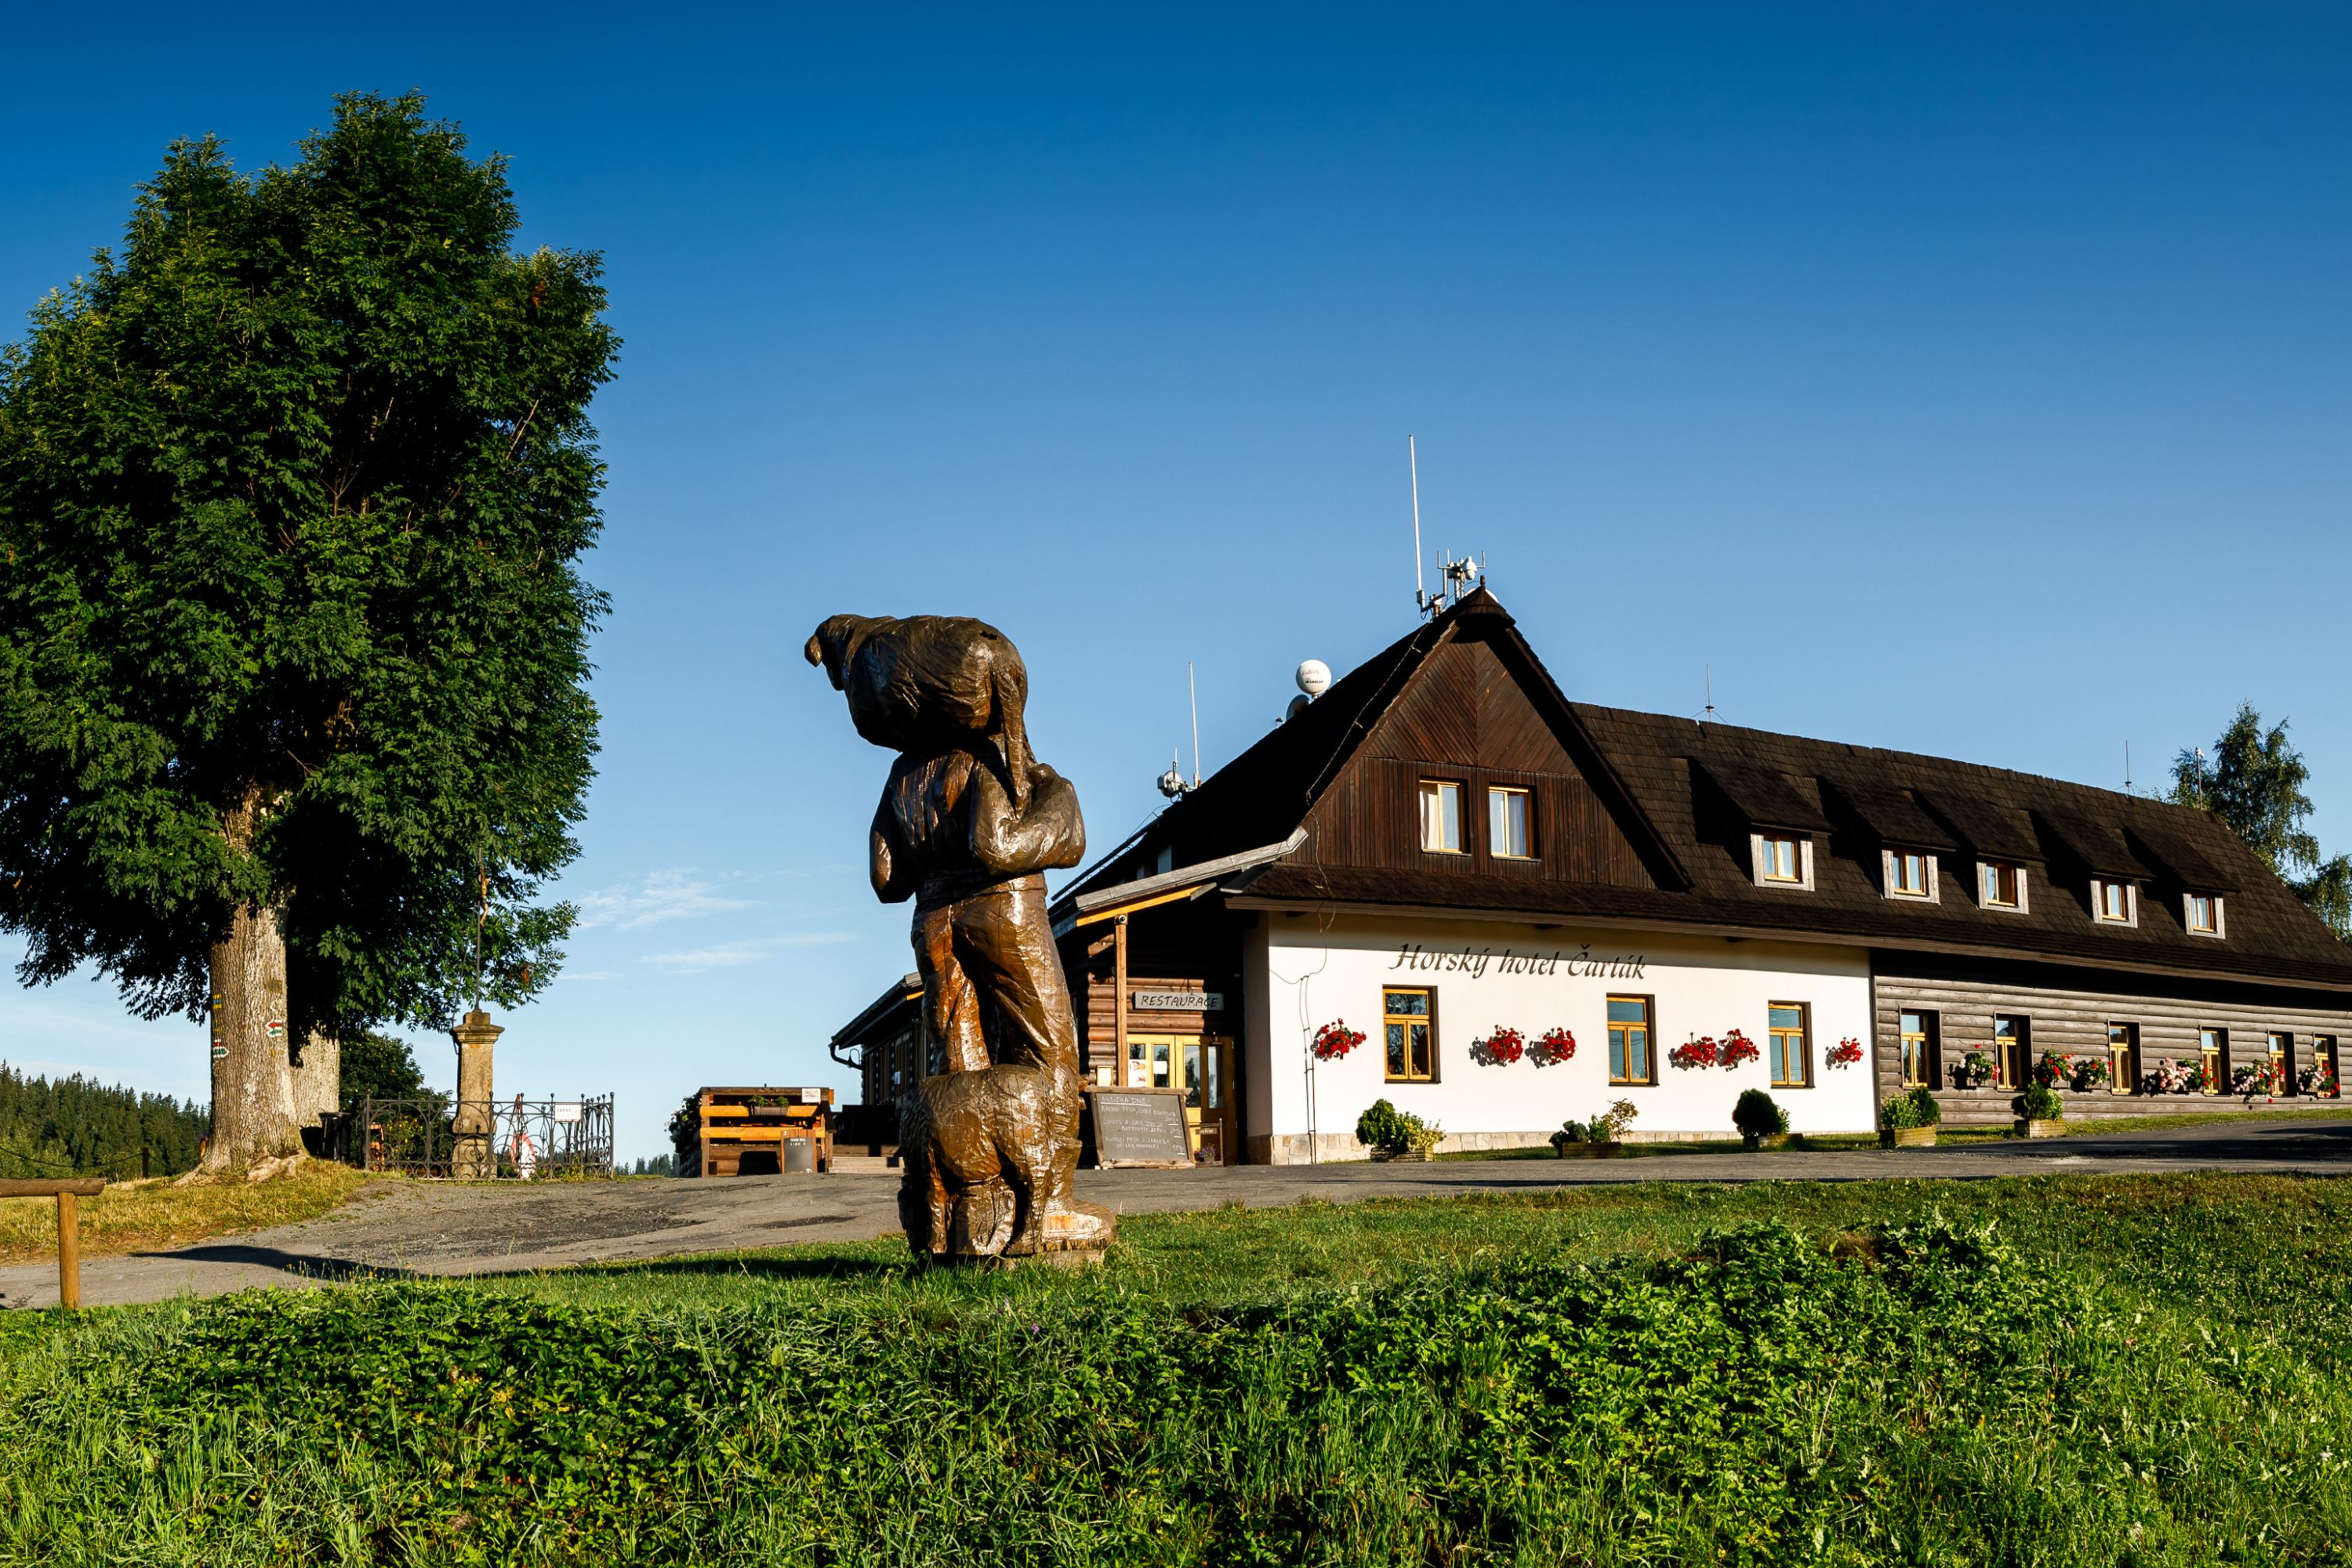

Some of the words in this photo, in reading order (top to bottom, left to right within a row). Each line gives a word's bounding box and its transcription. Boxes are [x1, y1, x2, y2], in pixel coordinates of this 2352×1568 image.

[1388, 943, 1490, 979] Horský
[1498, 948, 1559, 975] hotel
[1567, 943, 1646, 980] Čarták
[1141, 995, 1218, 1008] RESTAURACE
